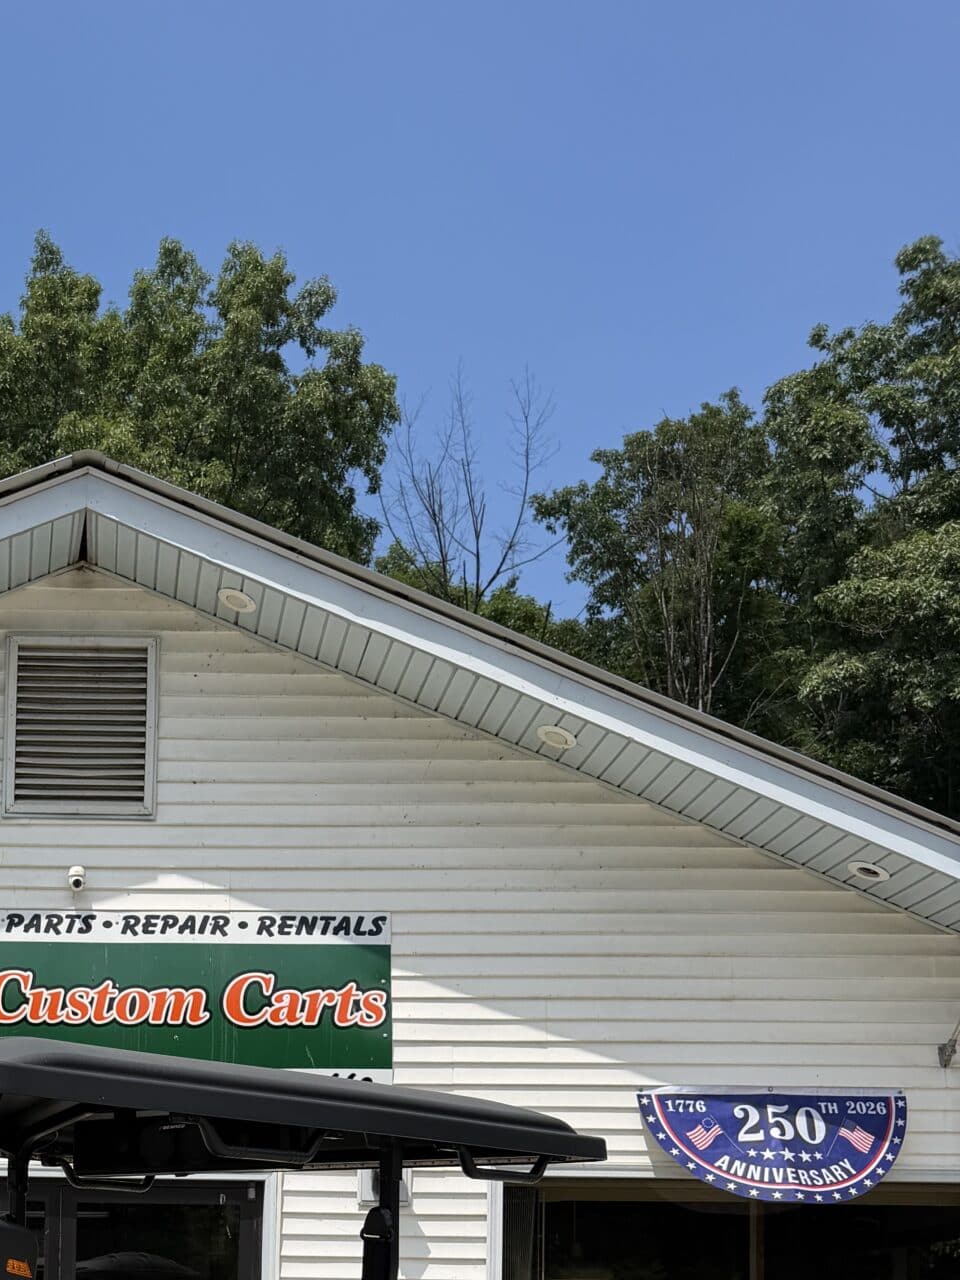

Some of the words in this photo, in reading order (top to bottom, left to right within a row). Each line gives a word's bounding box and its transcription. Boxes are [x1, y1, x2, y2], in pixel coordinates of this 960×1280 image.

[5, 913, 96, 935] PARTS
[121, 915, 230, 937] REPAIR
[256, 916, 387, 937] RENTALS
[222, 972, 387, 1026] Carts
[664, 1100, 707, 1113] 1776
[847, 1101, 887, 1115] 2026
[714, 1154, 857, 1187] ANNIVERSARY
